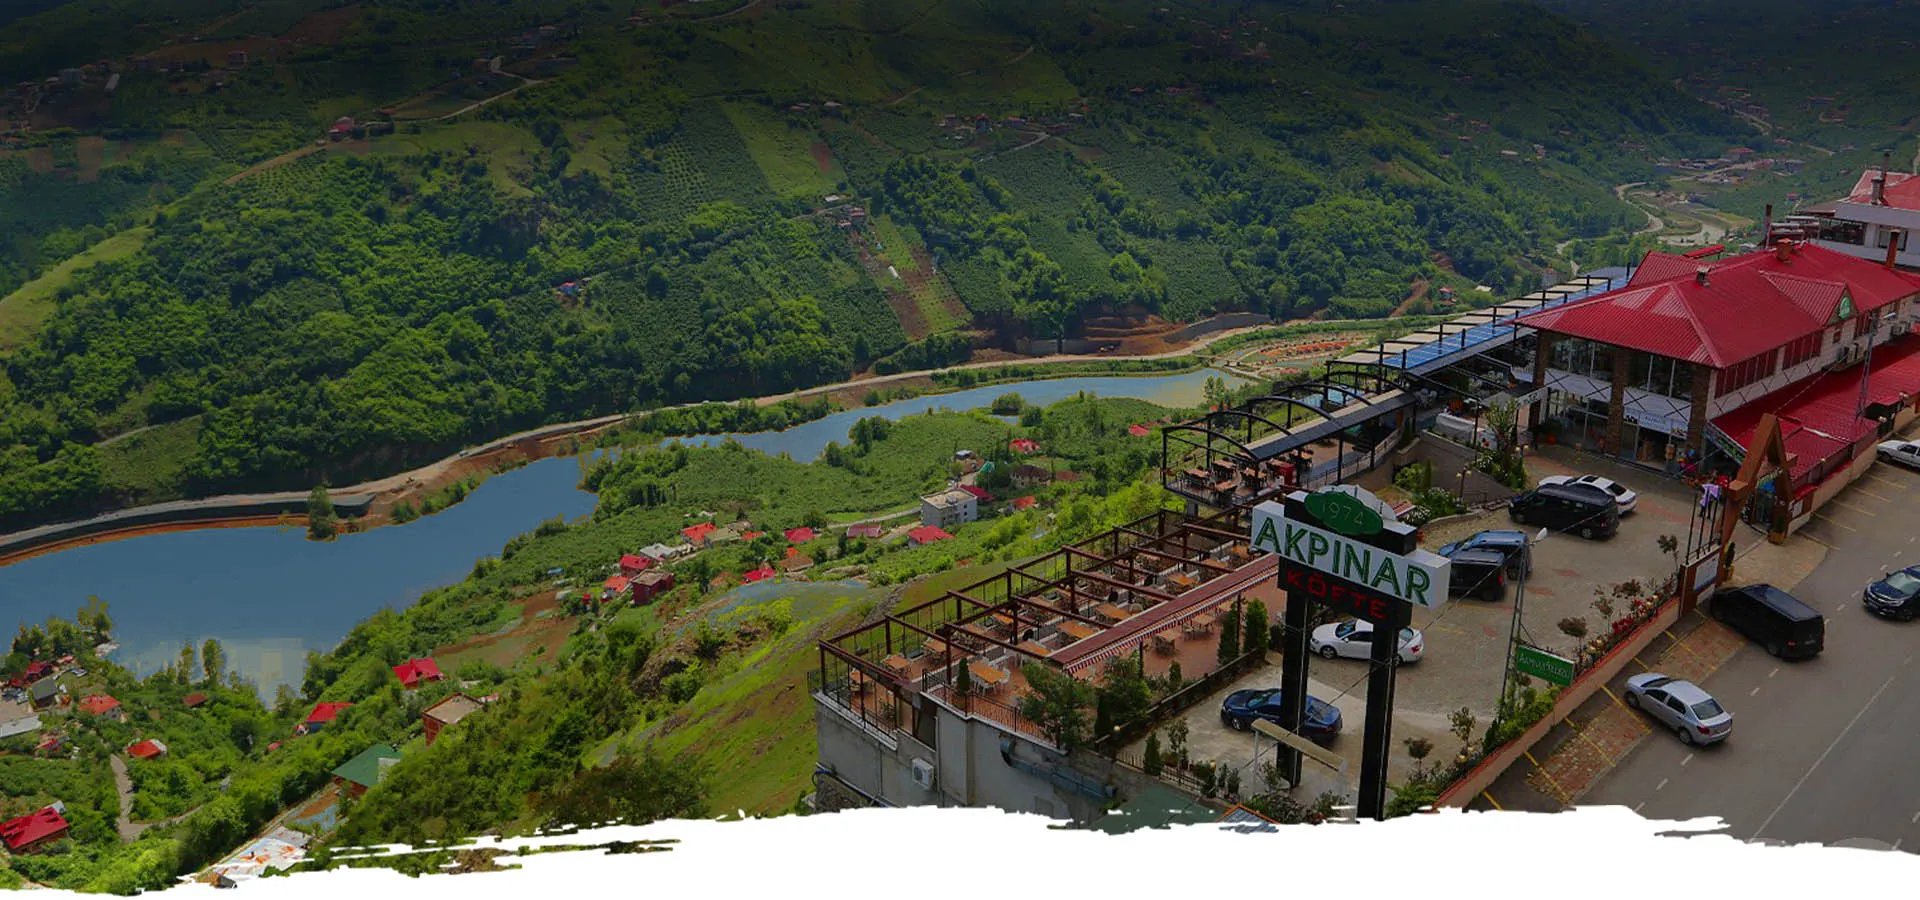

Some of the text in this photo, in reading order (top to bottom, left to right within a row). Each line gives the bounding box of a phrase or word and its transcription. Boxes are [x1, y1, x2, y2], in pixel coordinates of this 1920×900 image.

[1322, 501, 1364, 526] 1974
[1254, 516, 1431, 606] AKPINAR
[1286, 567, 1388, 620] KÖFTE
